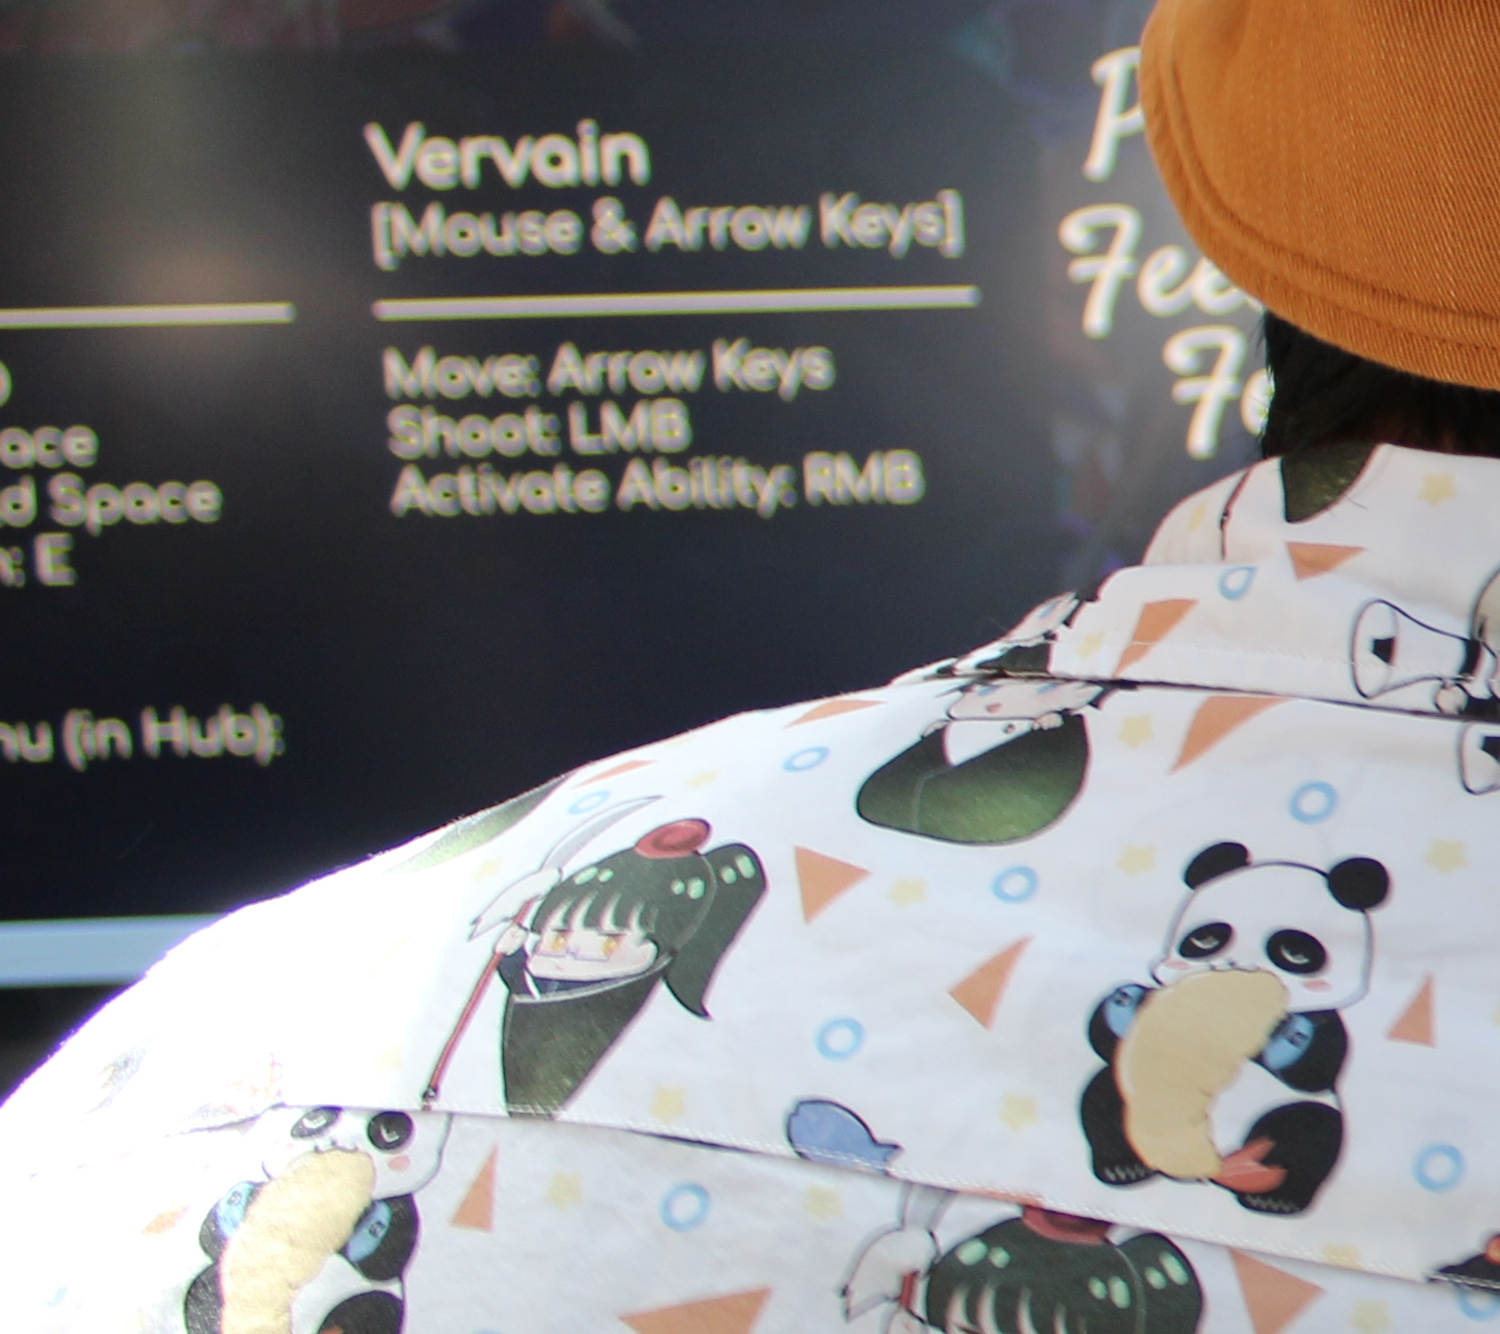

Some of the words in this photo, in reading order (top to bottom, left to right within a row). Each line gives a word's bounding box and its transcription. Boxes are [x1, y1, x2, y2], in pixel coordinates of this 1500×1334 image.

[363, 118, 651, 191] Vervain
[370, 201, 585, 271] [Mouse
[590, 196, 638, 255] &
[645, 195, 812, 252] Arrow
[820, 189, 965, 258] Keys]
[383, 346, 541, 400] Move:
[547, 341, 707, 396] Arrow
[712, 337, 836, 402] Keys
[388, 403, 561, 460] Shoot:
[568, 398, 693, 454] LMB
[48, 471, 224, 537] Space
[390, 462, 611, 517] Activate
[616, 455, 797, 519] Ability:
[803, 449, 926, 505] RMB
[34, 531, 78, 586] E
[63, 708, 132, 772] (in
[141, 702, 285, 767] Hub):
